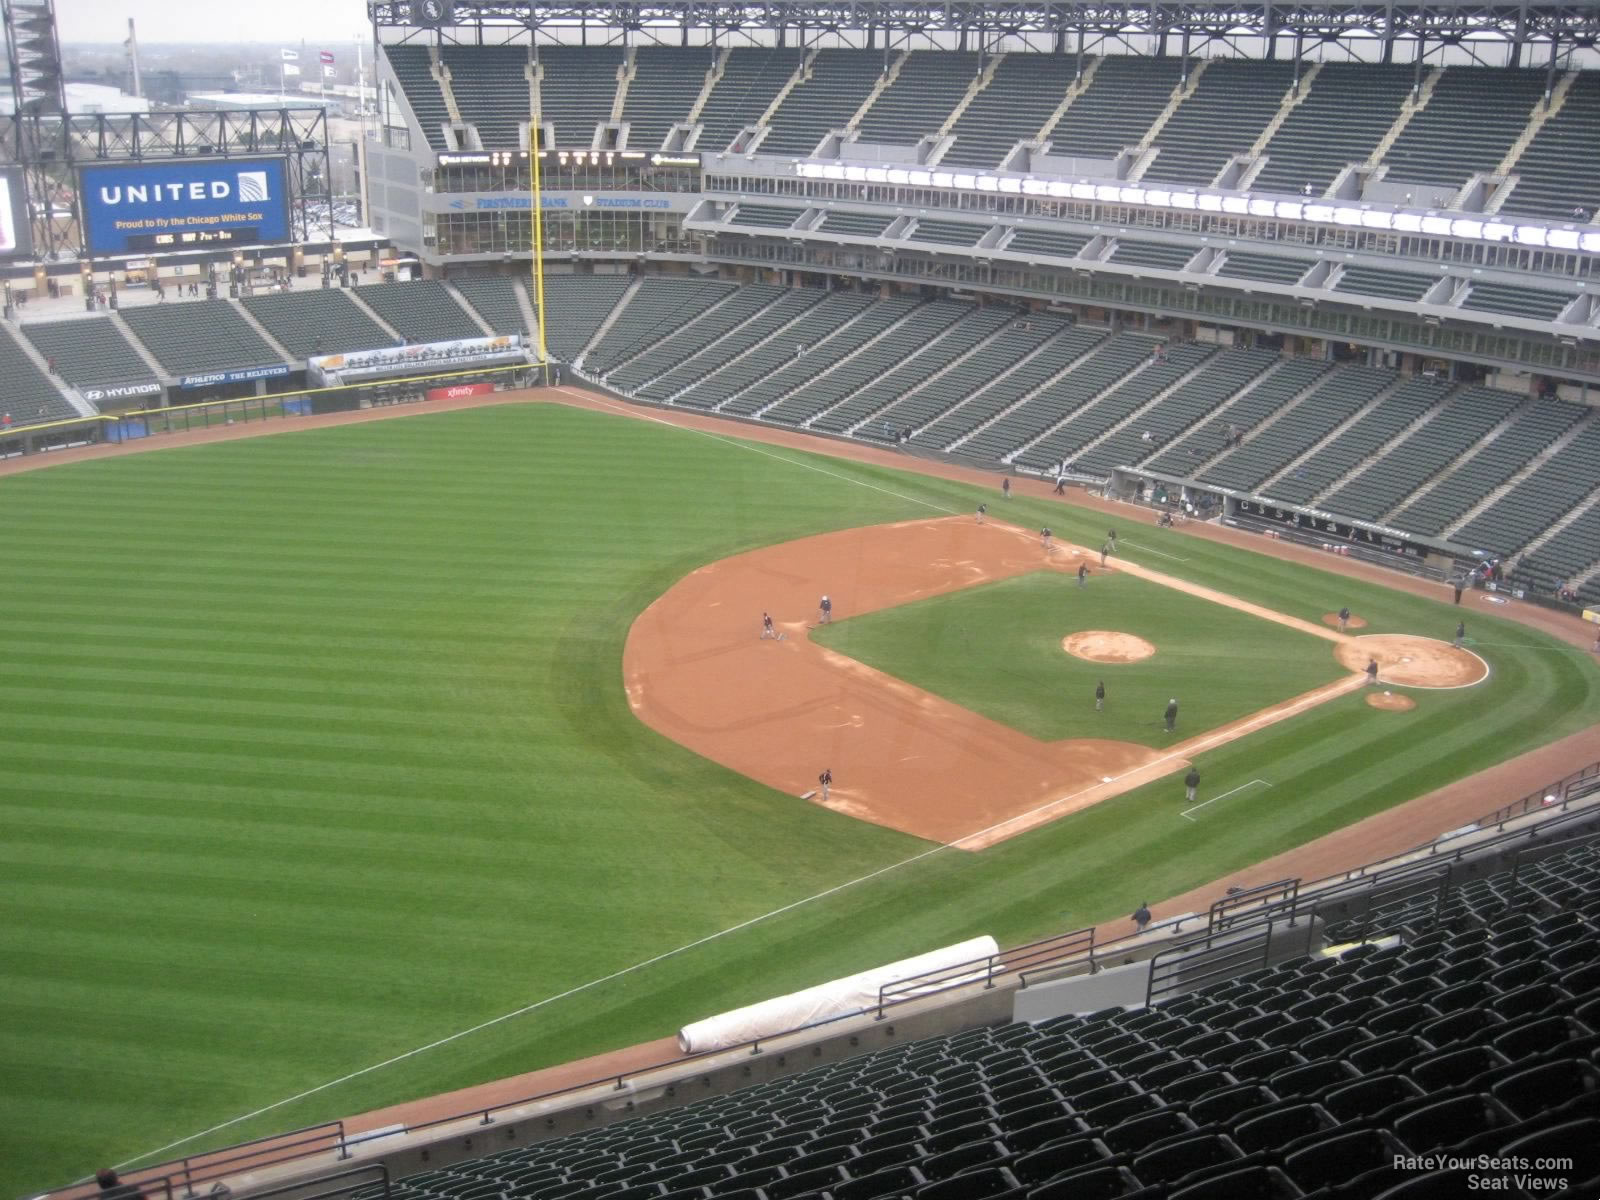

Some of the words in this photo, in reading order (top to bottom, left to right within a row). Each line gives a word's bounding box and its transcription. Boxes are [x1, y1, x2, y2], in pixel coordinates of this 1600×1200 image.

[101, 181, 231, 205] UNITED
[541, 196, 569, 208] BANK
[596, 198, 642, 208] STADIUM
[643, 199, 671, 209] CLUB
[116, 219, 143, 230] Proud
[145, 219, 155, 228] to
[156, 218, 169, 229] fly
[170, 216, 185, 226] the
[186, 214, 220, 226] Chicago
[221, 212, 246, 222] White
[247, 211, 263, 221] Sox
[184, 373, 226, 385] ATHLETICO
[230, 372, 245, 380] THE
[246, 367, 287, 378] RELIEVERS
[106, 383, 161, 398] HYUNDAI
[447, 386, 474, 398] xfinity
